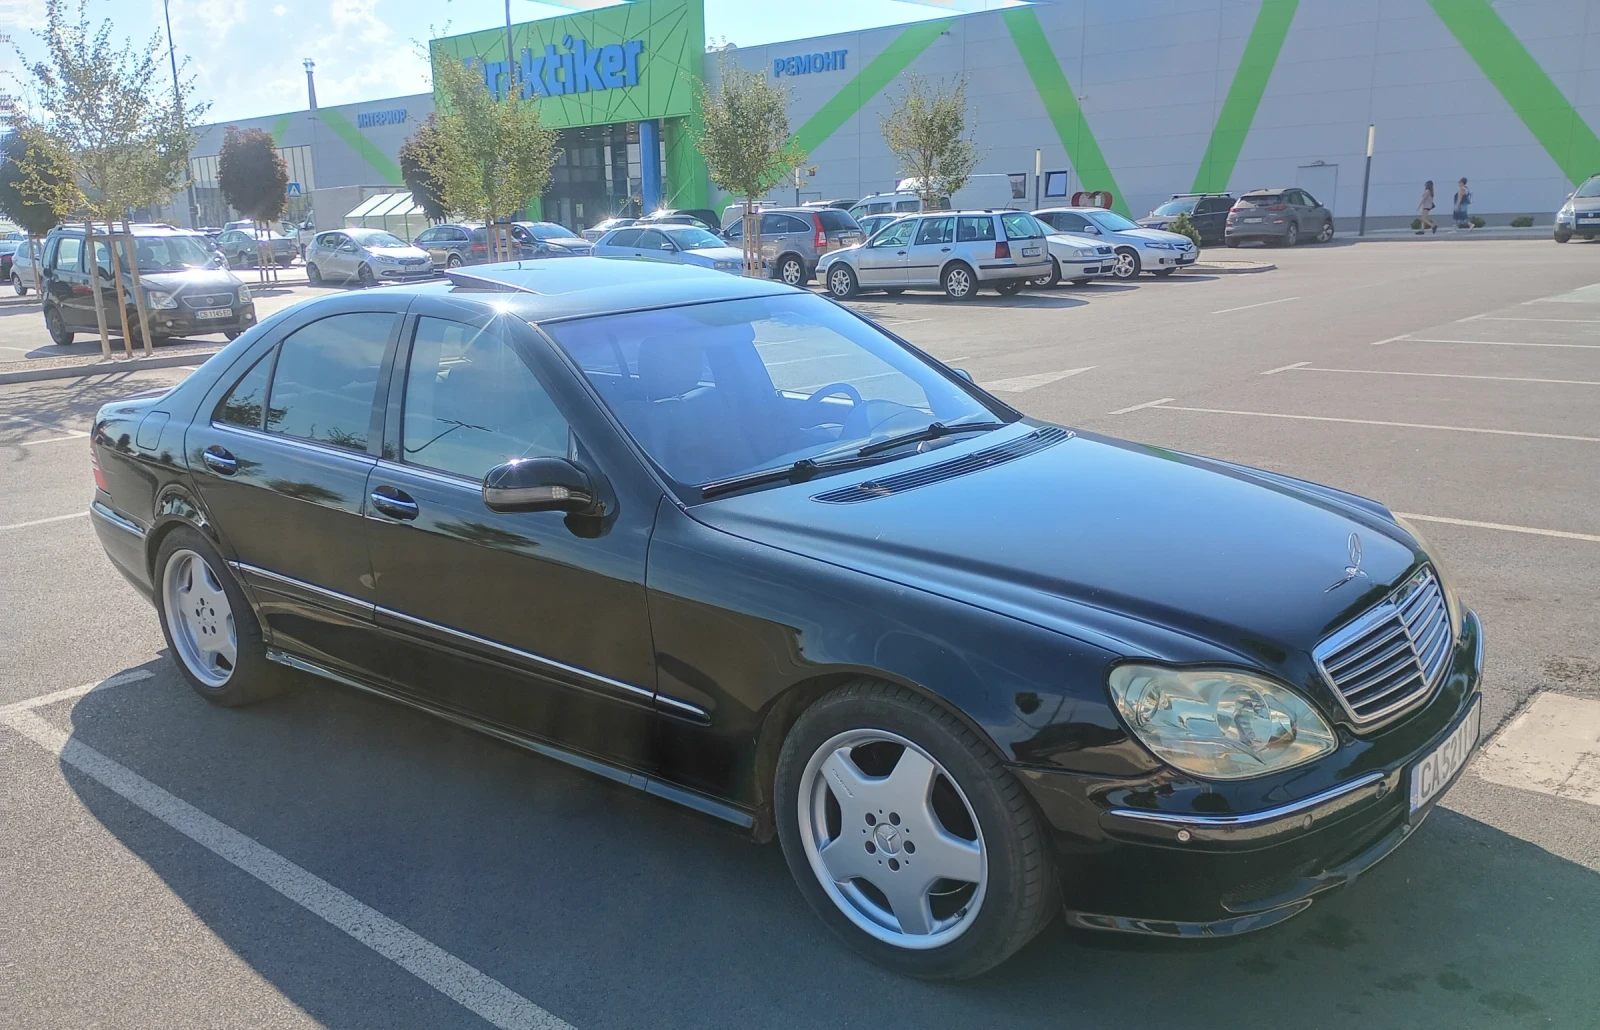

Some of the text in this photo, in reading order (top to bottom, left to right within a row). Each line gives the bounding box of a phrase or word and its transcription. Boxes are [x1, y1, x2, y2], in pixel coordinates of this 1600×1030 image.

[463, 34, 644, 103] raktiker
[774, 49, 848, 78] РЕМОНТ
[358, 109, 406, 128] ИНТЕРИОР
[1421, 753, 1440, 799] CA
